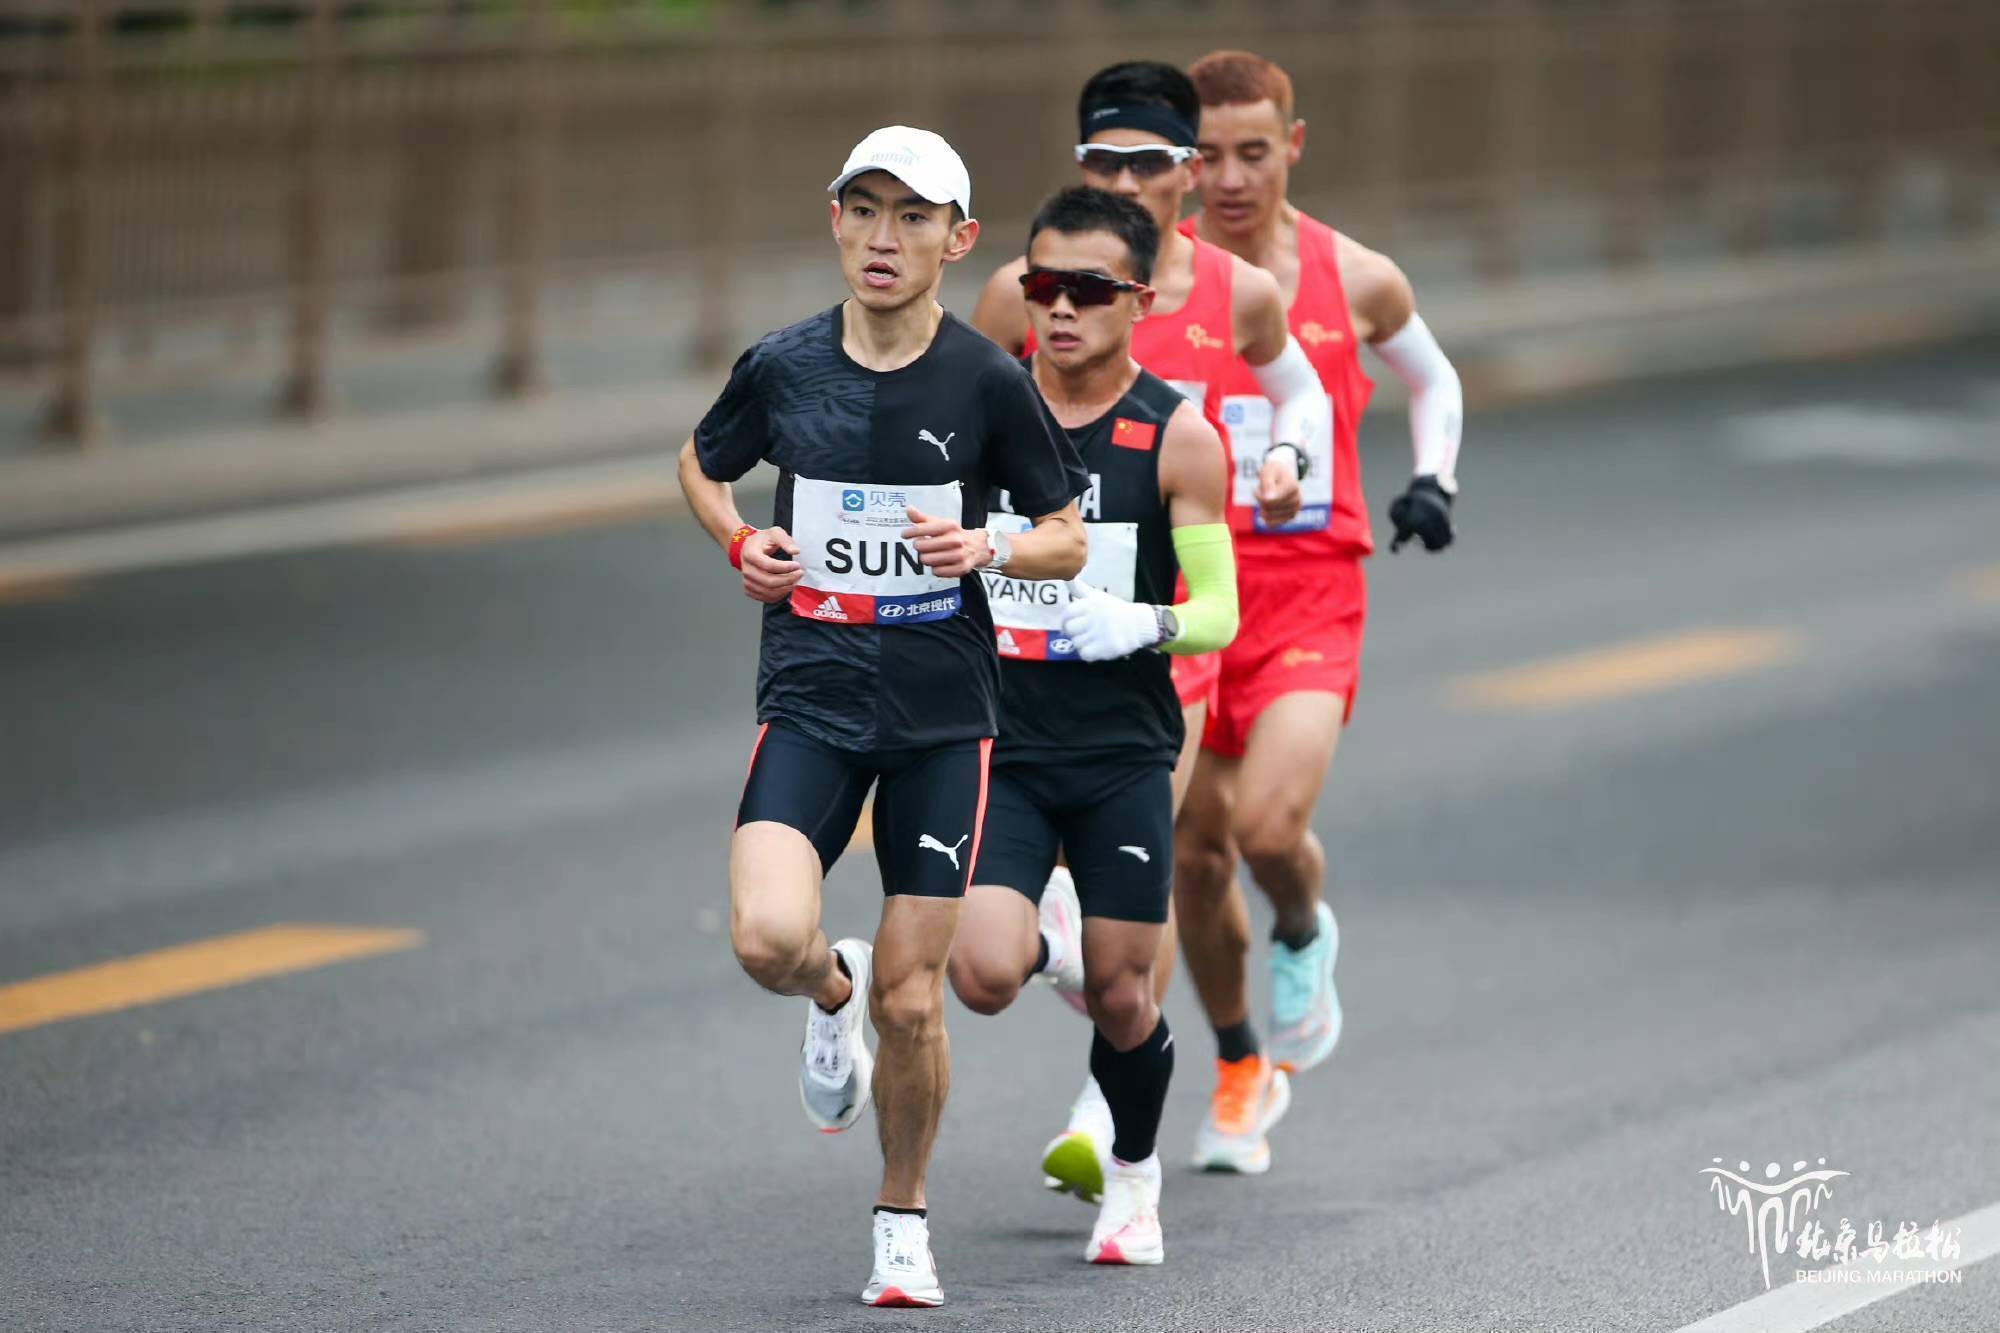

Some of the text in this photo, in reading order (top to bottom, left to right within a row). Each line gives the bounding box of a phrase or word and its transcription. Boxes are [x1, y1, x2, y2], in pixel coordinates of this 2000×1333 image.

[869, 491, 907, 508] 贝壳
[825, 537, 924, 577] SUN
[984, 575, 1058, 606] YANG
[812, 608, 849, 620] adidas
[906, 597, 957, 616] 北京现代
